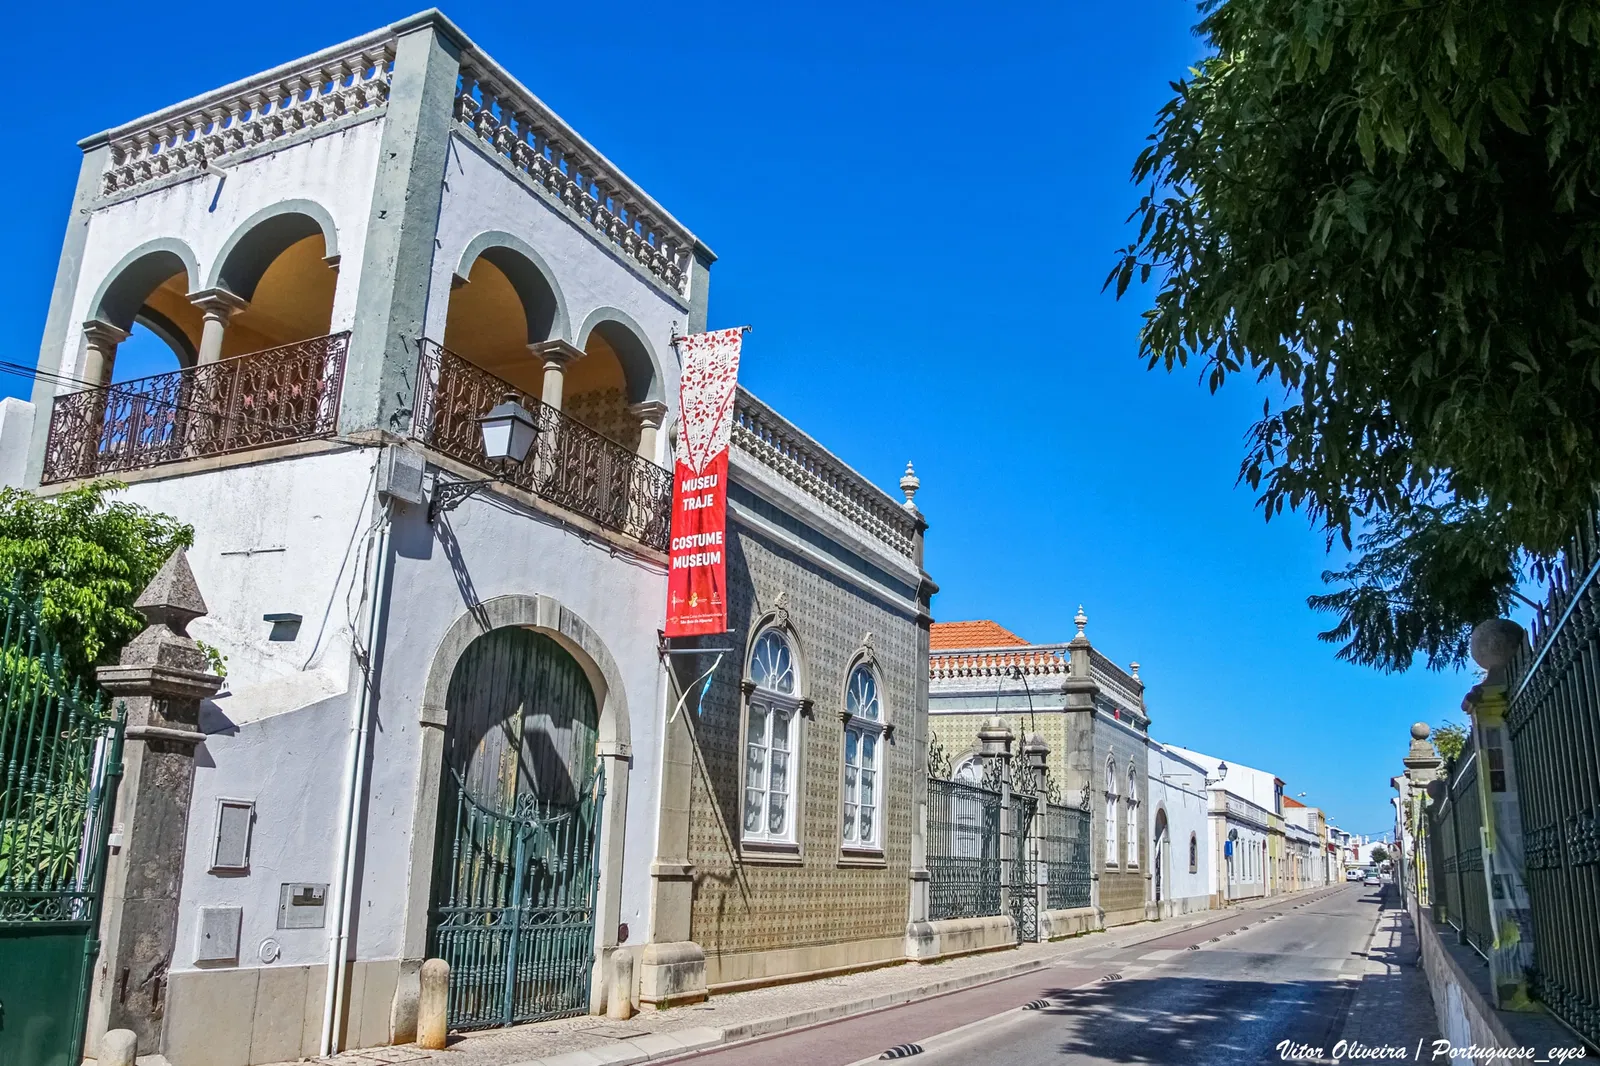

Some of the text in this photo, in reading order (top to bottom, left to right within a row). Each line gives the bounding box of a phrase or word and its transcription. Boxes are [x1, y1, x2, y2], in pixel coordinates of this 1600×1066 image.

[681, 474, 718, 493] MUSEU
[682, 494, 714, 511] TRAJE
[672, 531, 723, 551] COSTUME
[672, 551, 721, 570] MUSEUM
